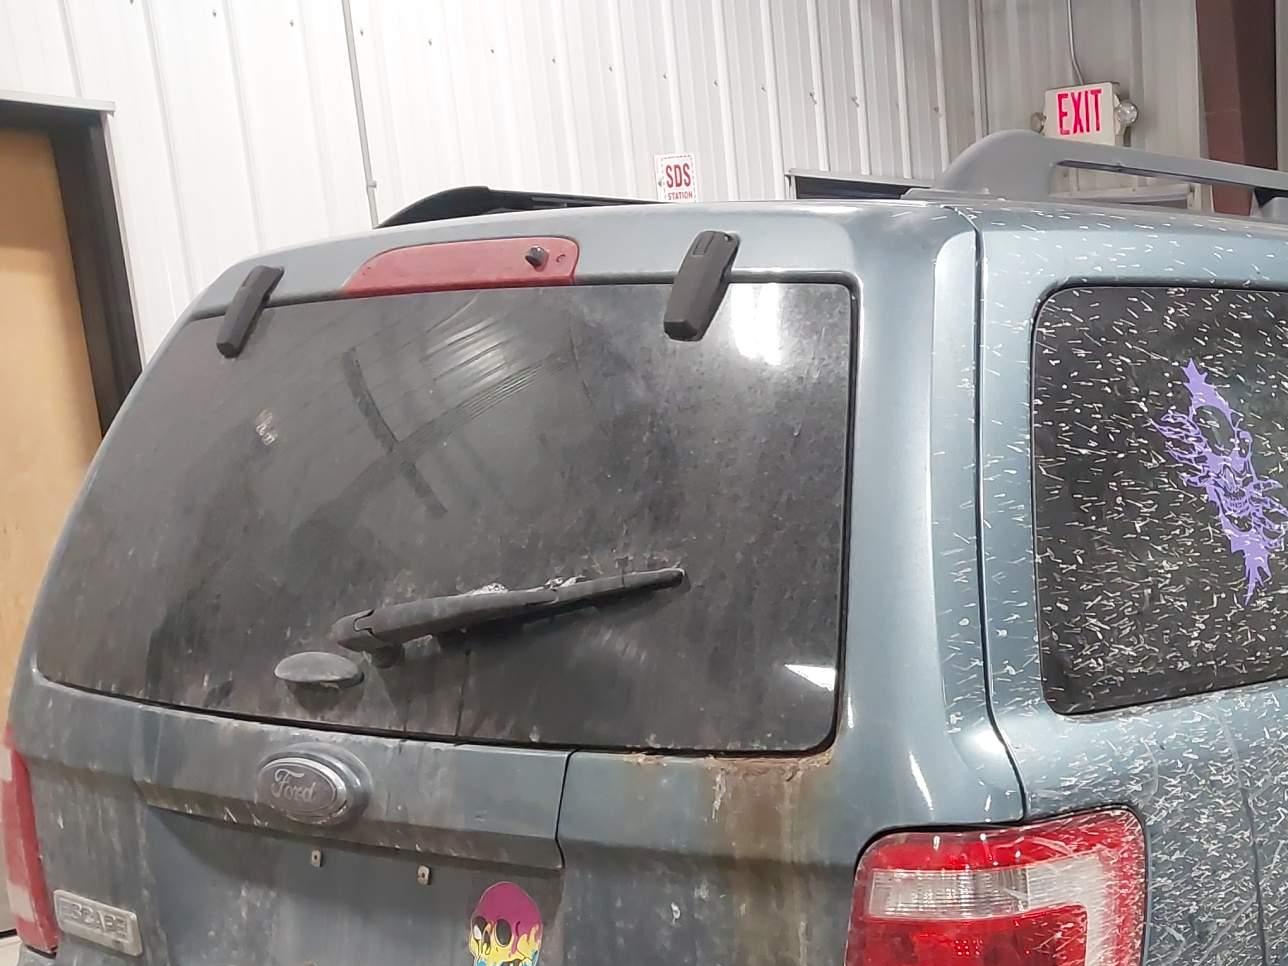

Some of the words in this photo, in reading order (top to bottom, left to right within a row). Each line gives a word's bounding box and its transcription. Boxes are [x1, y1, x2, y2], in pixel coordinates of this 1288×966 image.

[1057, 88, 1103, 136] EXIT
[665, 162, 692, 189] SDS
[667, 191, 693, 201] STATION
[271, 768, 317, 802] Ford
